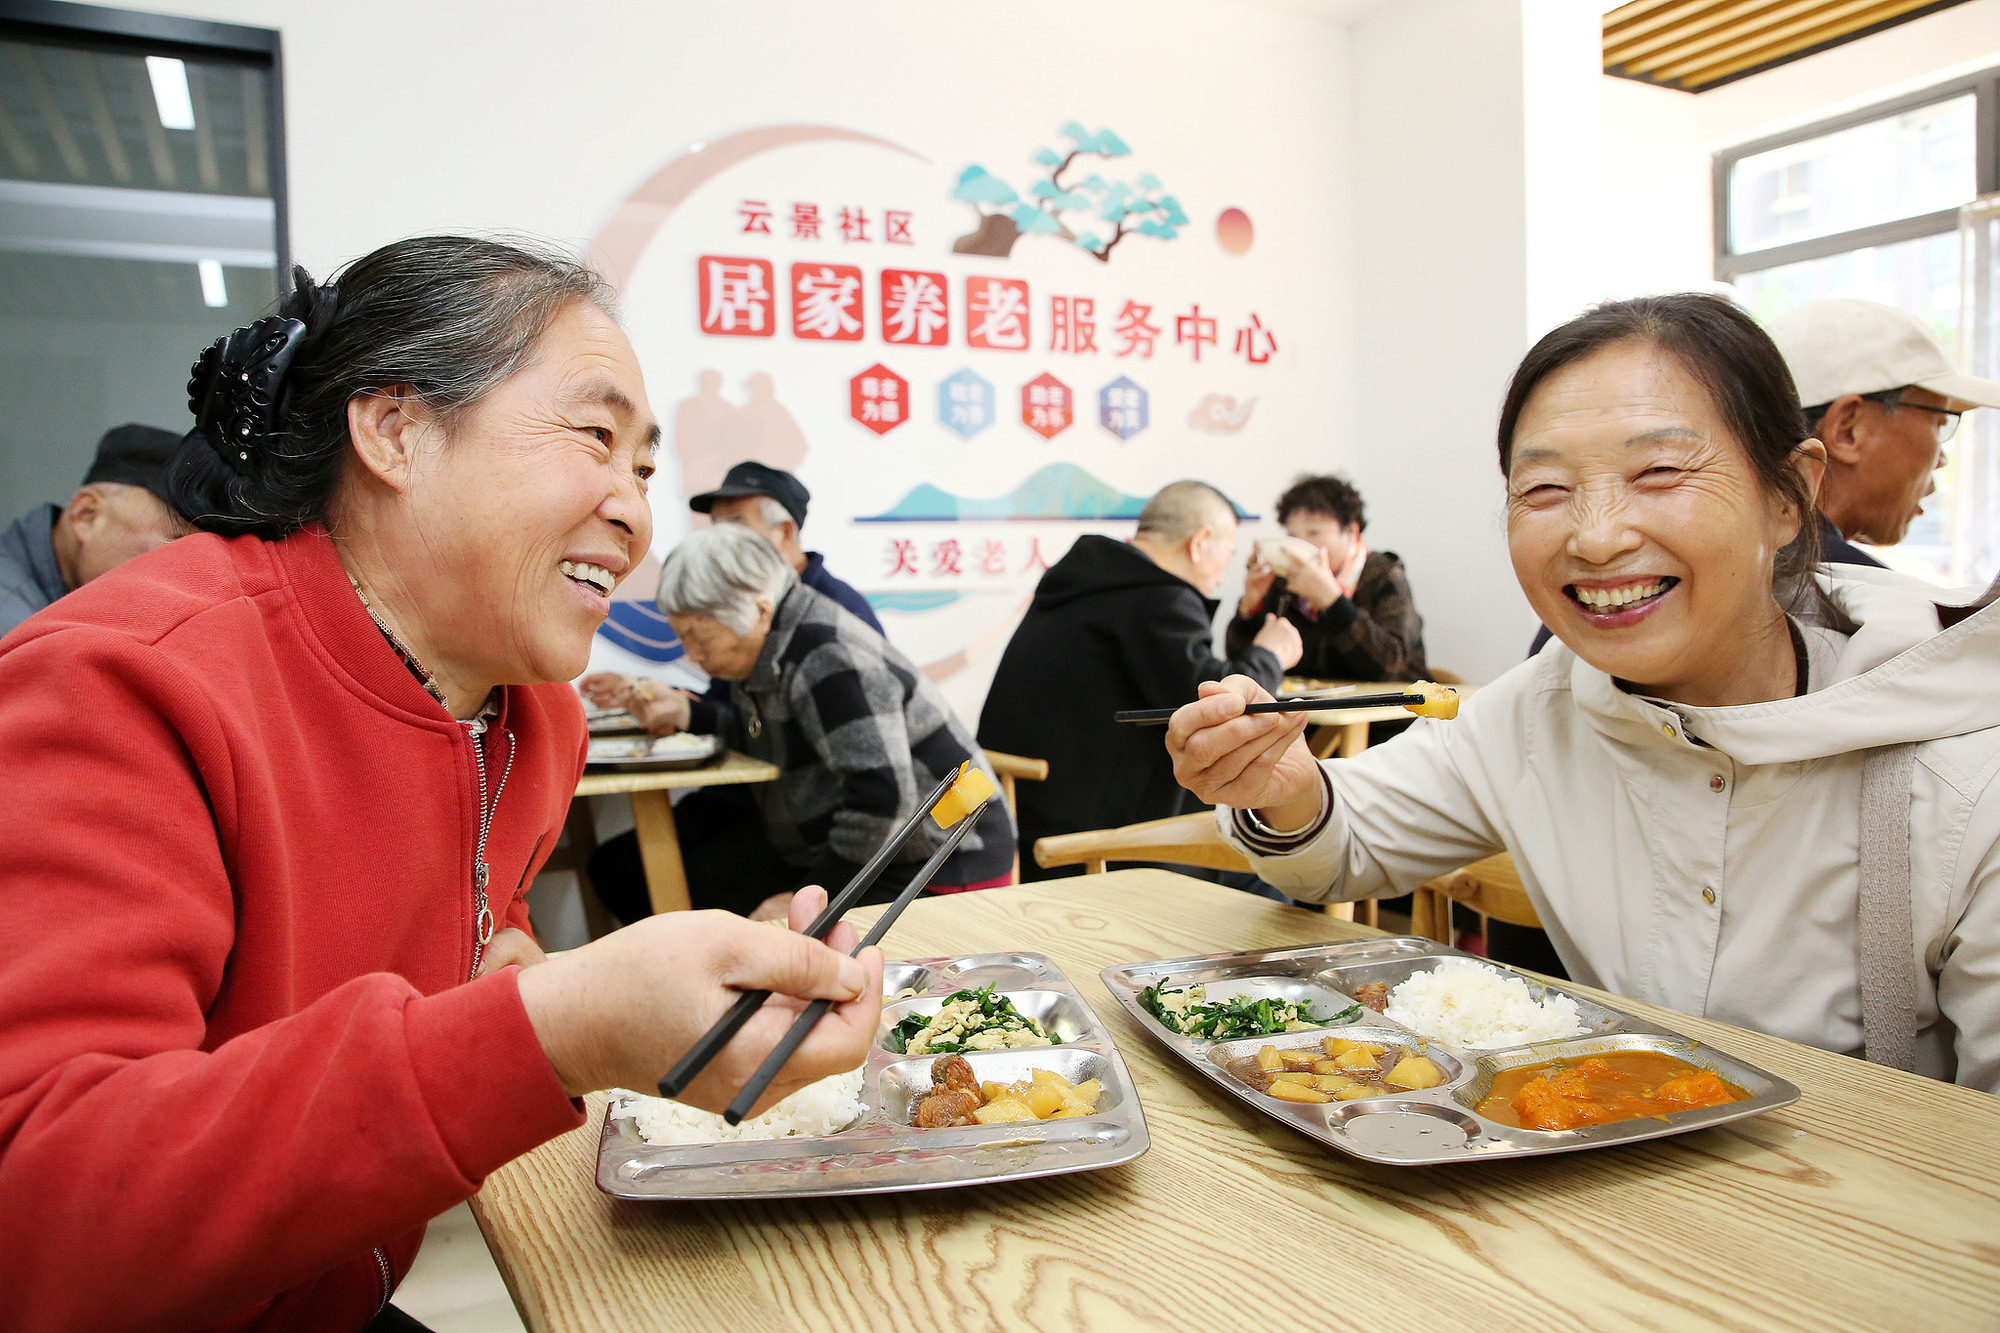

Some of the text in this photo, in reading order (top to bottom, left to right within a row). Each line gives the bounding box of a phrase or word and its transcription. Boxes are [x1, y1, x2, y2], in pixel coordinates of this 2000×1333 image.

[738, 201, 915, 246] 云景社区
[704, 260, 1277, 364] 居家养老服务中心
[885, 536, 1051, 577] 关爱老人
